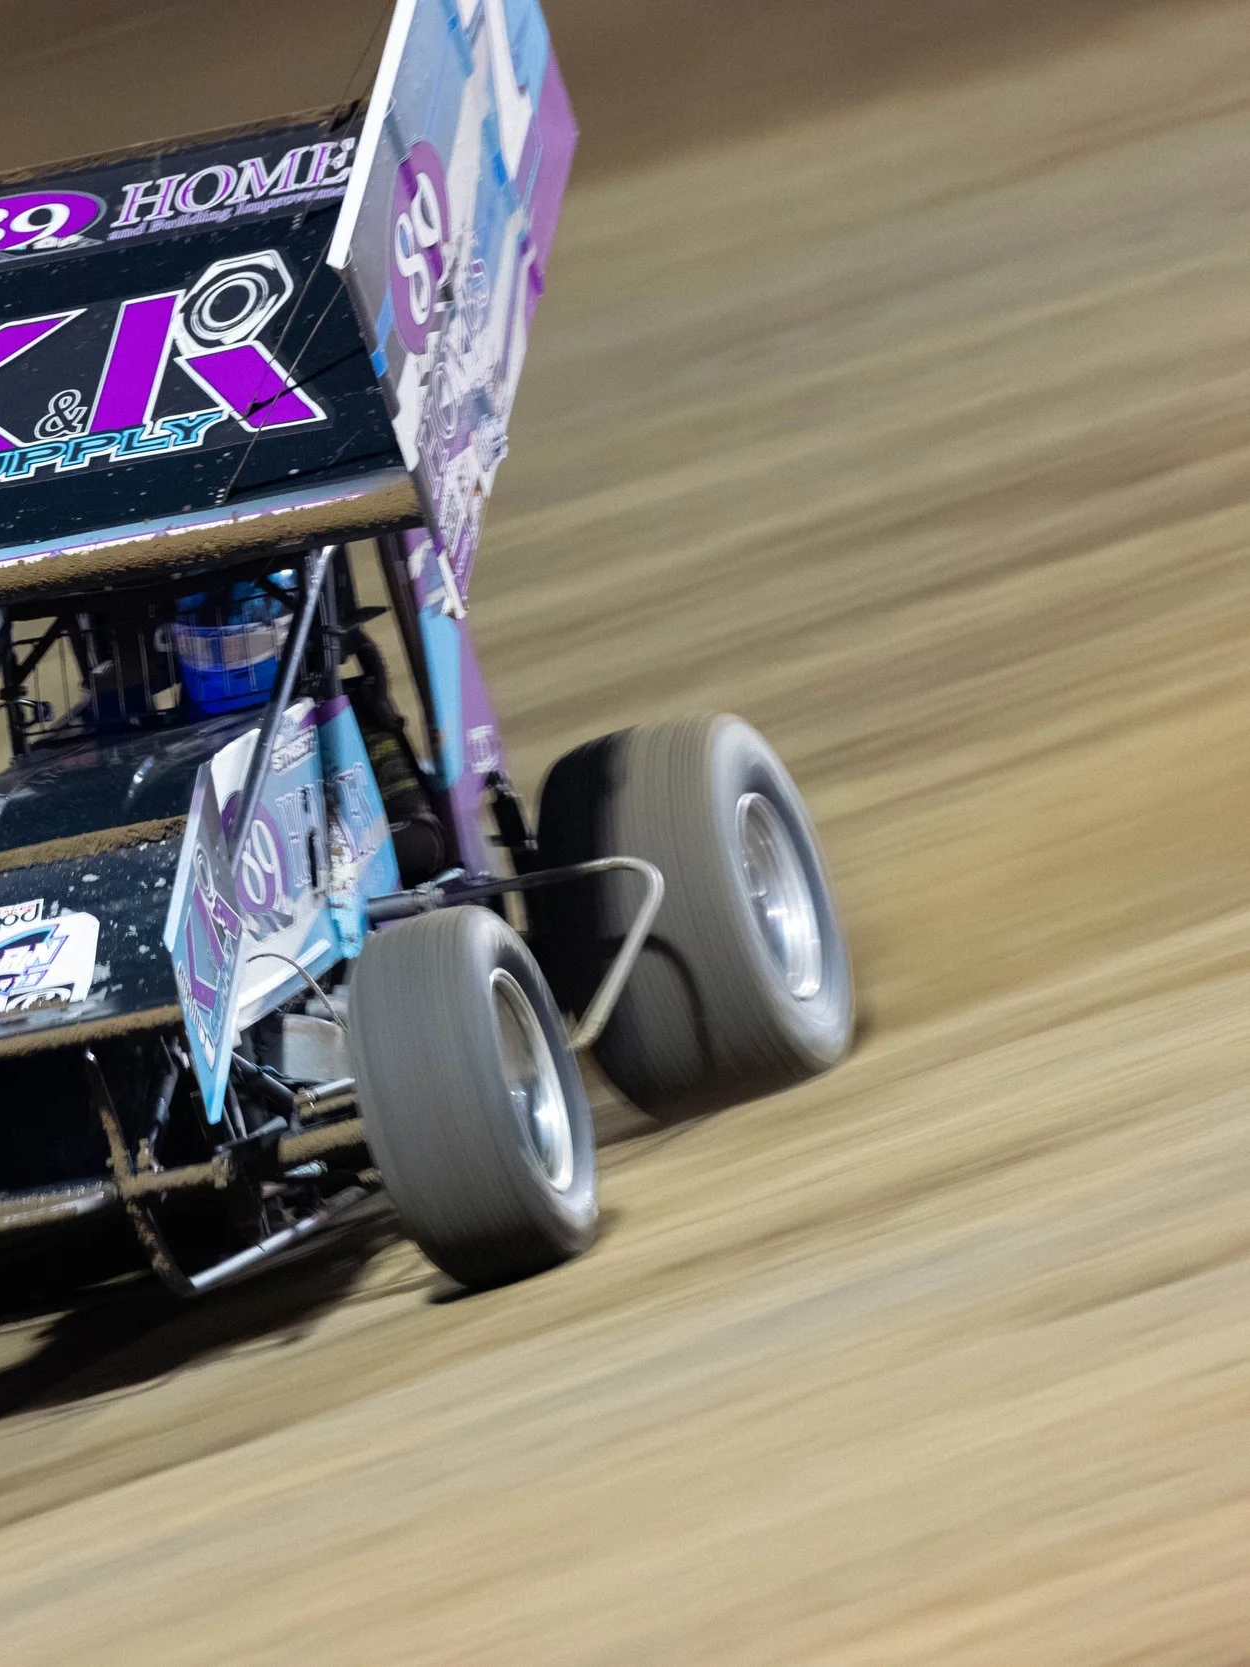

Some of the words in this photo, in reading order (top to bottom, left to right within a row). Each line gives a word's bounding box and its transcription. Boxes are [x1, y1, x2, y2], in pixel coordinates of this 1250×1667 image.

[110, 137, 356, 228] HOME
[148, 207, 234, 234] Building
[394, 171, 447, 326] 89
